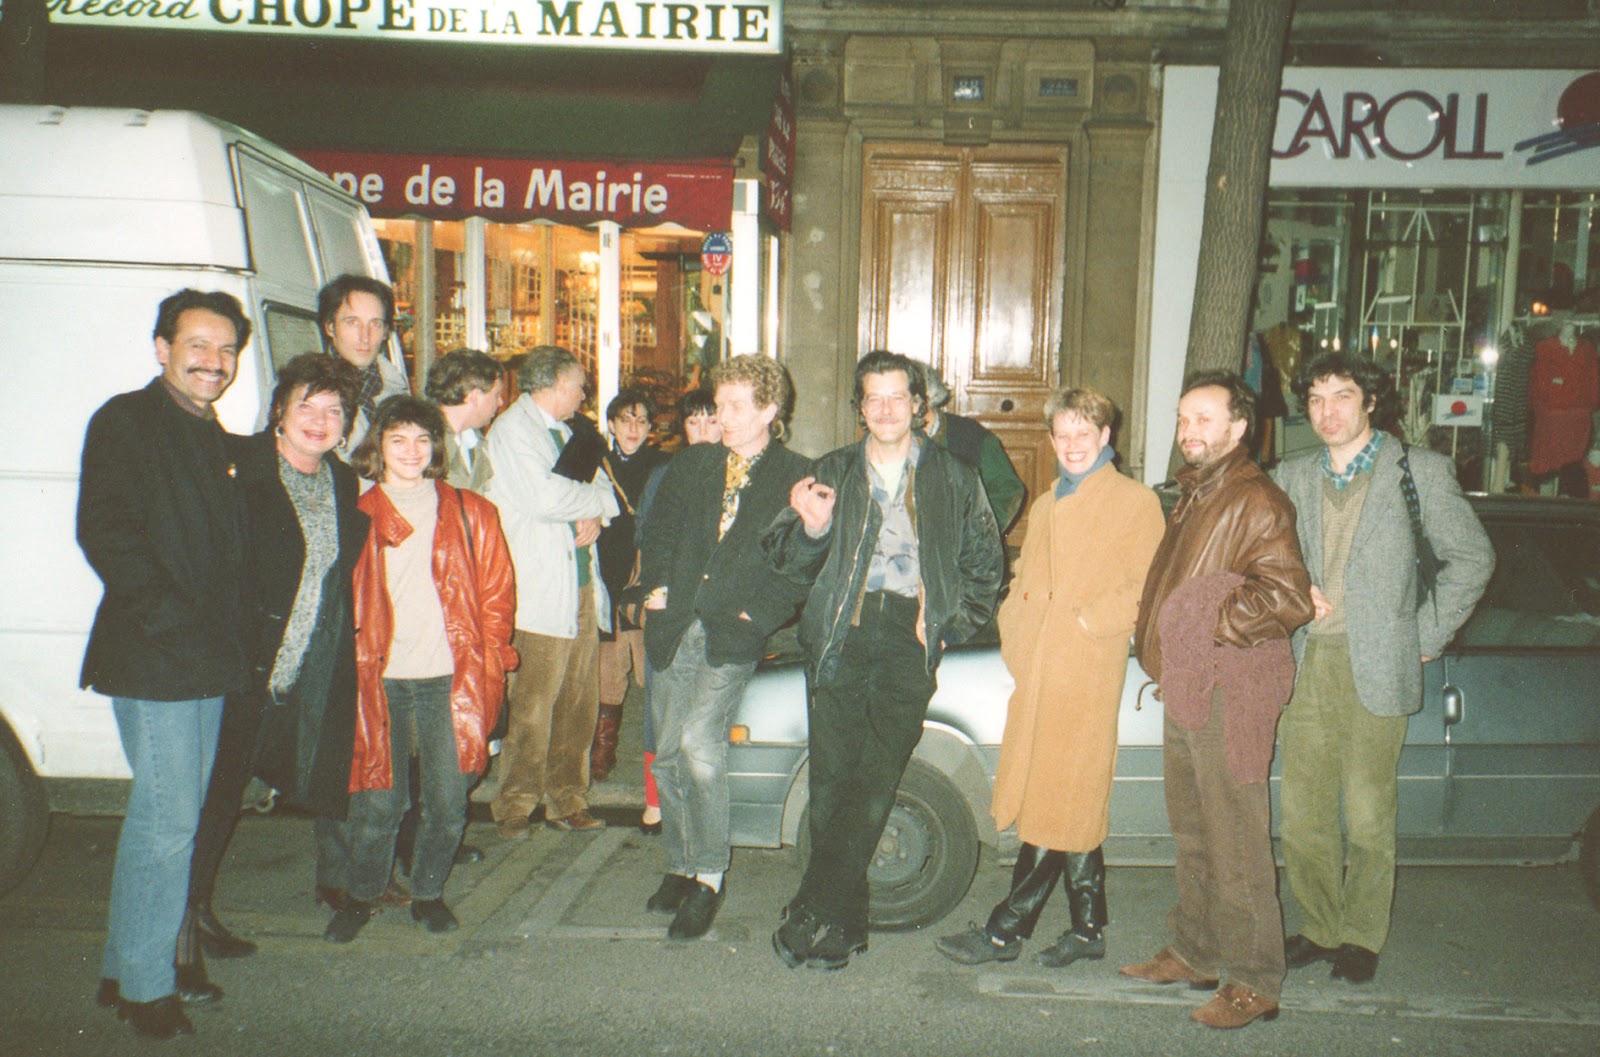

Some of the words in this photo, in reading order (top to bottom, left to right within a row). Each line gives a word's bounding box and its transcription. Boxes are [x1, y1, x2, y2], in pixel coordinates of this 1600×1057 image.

[208, 0, 415, 31] CHOPE
[428, 8, 467, 33] DE
[479, 10, 522, 35] LA
[537, 0, 769, 43] MAIRIE
[321, 171, 384, 203] pe
[405, 164, 456, 206] de
[474, 166, 505, 209] la
[524, 168, 668, 214] Mairie
